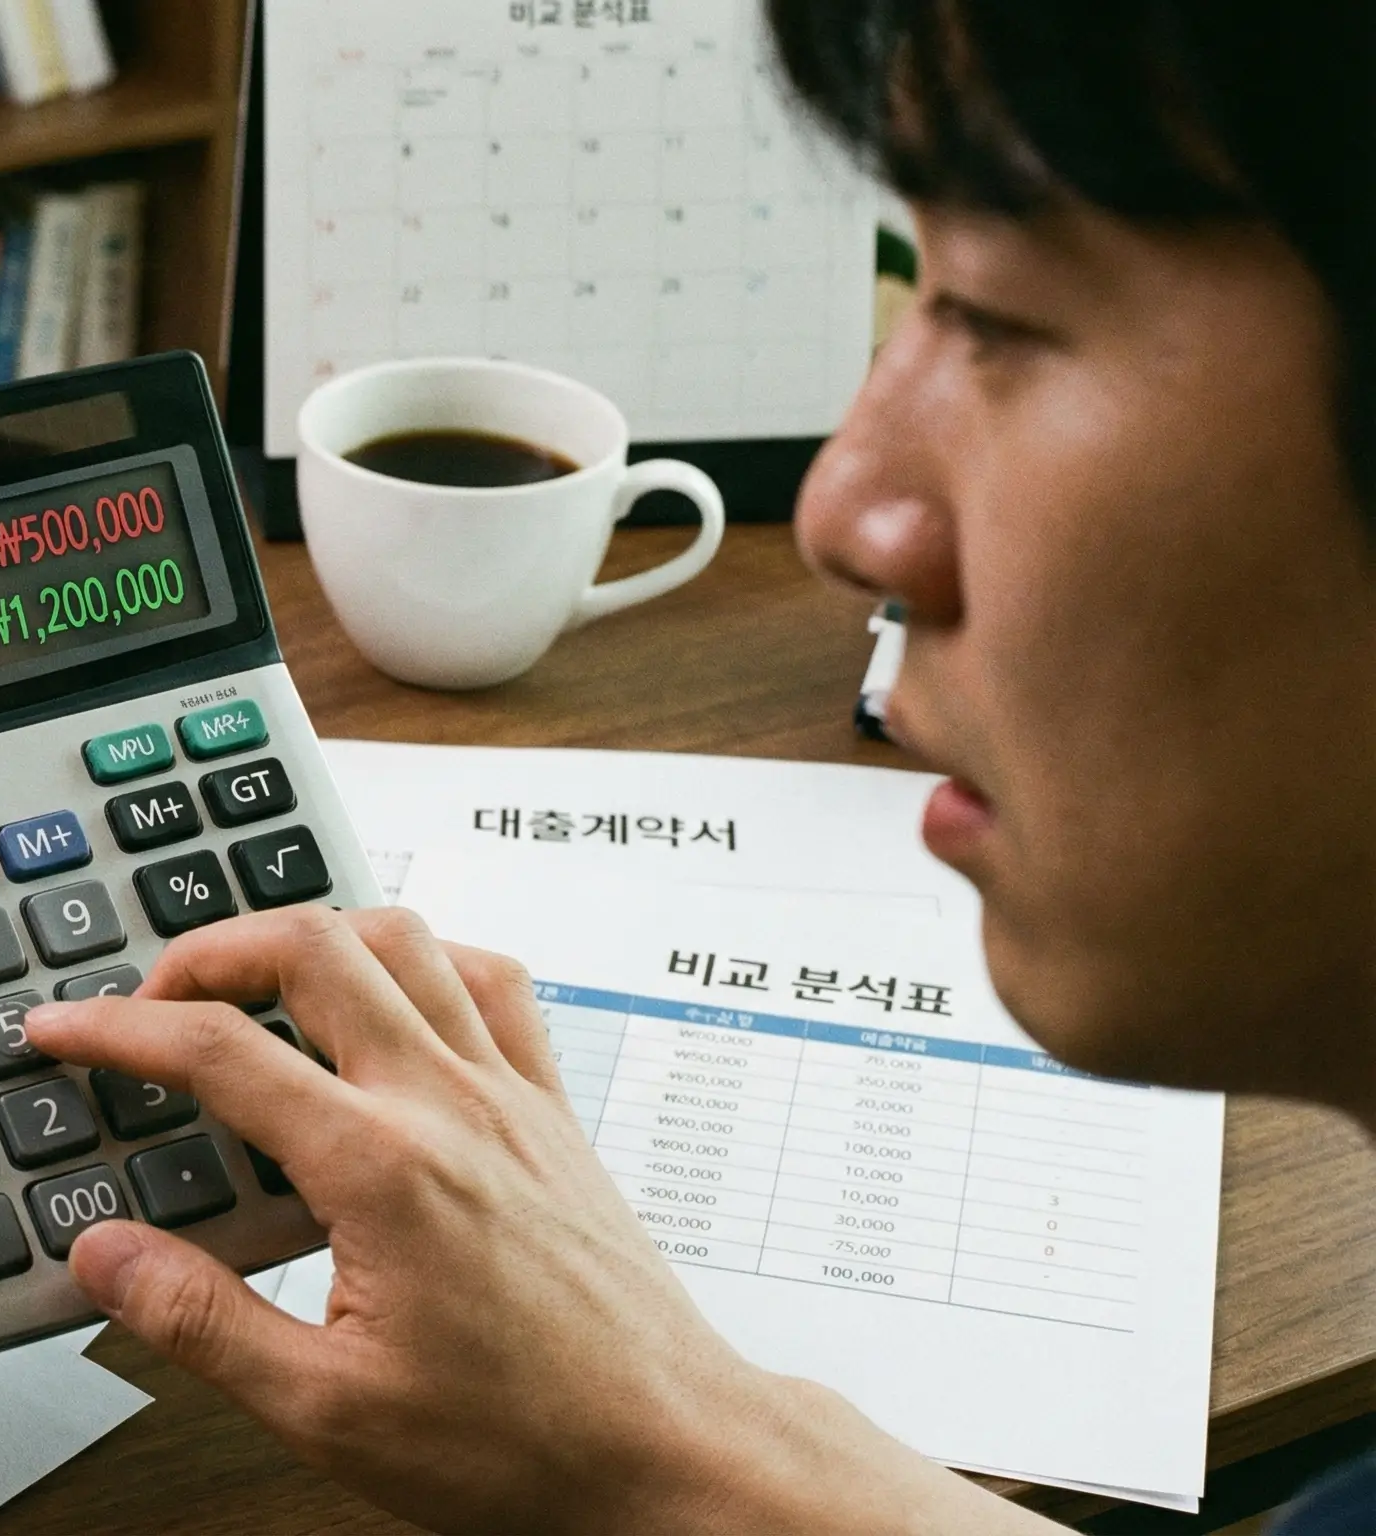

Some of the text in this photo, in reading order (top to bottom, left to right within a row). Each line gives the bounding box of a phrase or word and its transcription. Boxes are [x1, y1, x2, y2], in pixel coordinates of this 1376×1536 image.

[230, 769, 271, 803] GT
[129, 796, 184, 830] M+
[472, 805, 738, 852] 대출계약서
[16, 824, 73, 860] M+
[169, 871, 210, 906] %
[62, 898, 91, 936] 9
[667, 949, 770, 992] 비교
[790, 965, 954, 1017] 분석표
[32, 1097, 67, 1137] 2
[49, 1180, 118, 1228] 000
